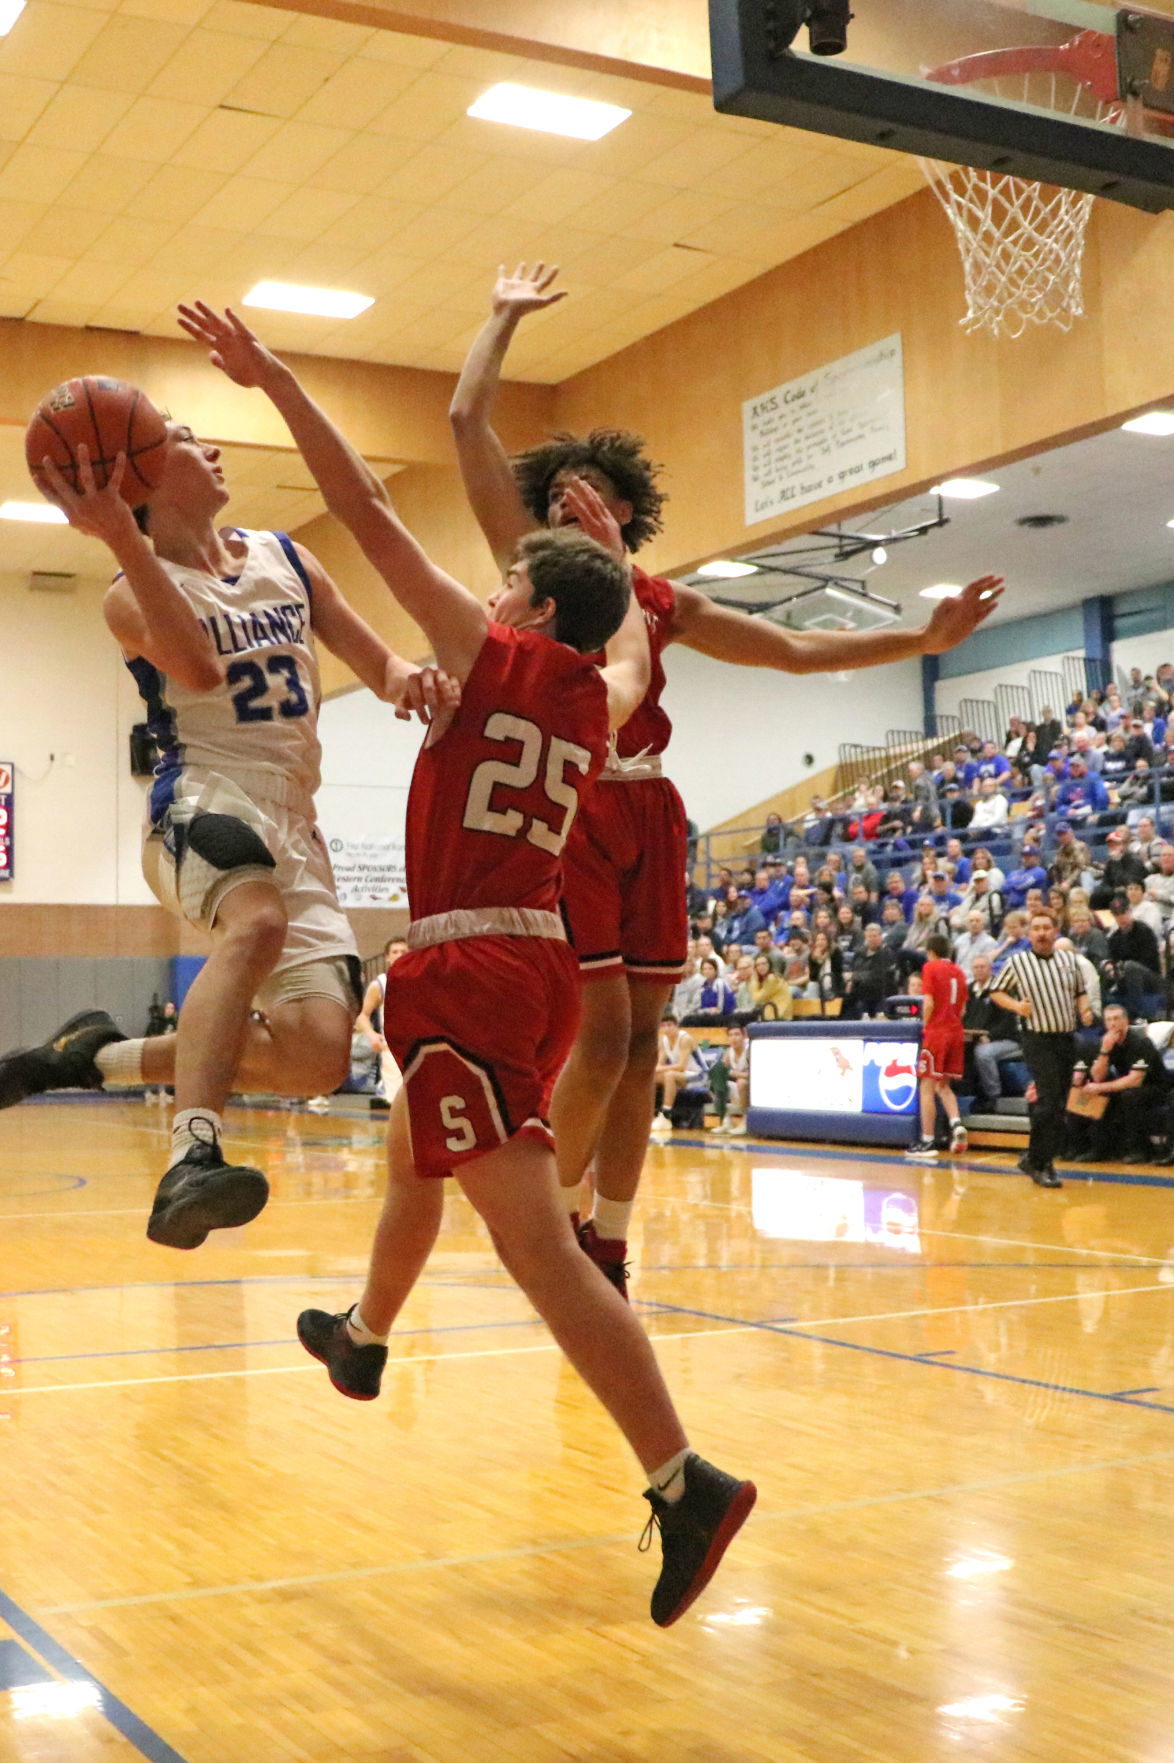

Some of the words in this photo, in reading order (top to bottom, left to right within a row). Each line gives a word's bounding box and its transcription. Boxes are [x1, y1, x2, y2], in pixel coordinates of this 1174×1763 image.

[800, 480, 823, 496] have
[227, 655, 309, 724] 23
[462, 712, 592, 857] 25
[950, 977, 958, 1005] 1
[440, 1095, 477, 1152] S
